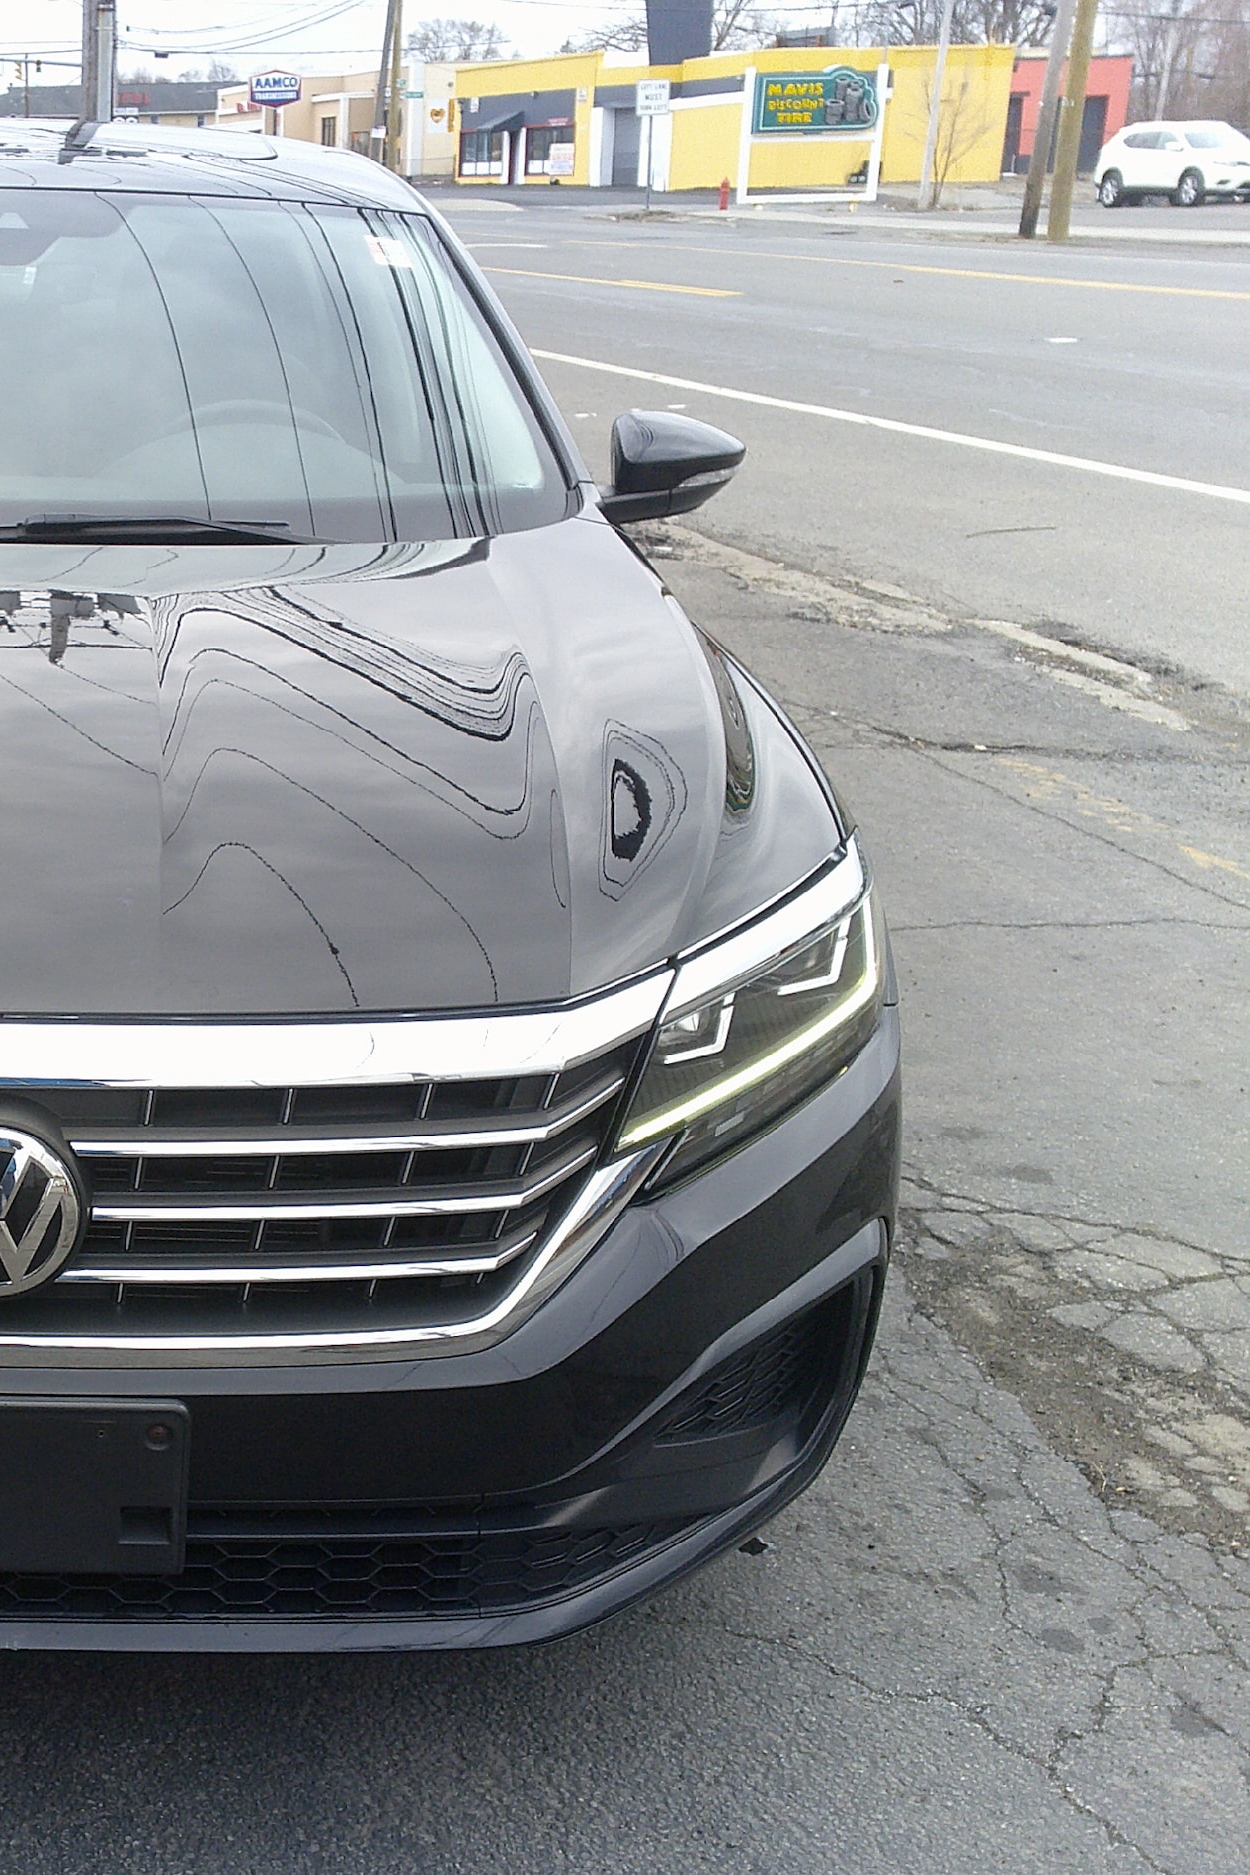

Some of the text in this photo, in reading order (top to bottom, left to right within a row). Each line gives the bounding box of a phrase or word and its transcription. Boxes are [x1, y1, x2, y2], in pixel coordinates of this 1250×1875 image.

[255, 77, 298, 89] AAMCO
[767, 82, 824, 96] MAVIS
[768, 98, 825, 110] DISCOUNT
[776, 112, 812, 123] TIRE
